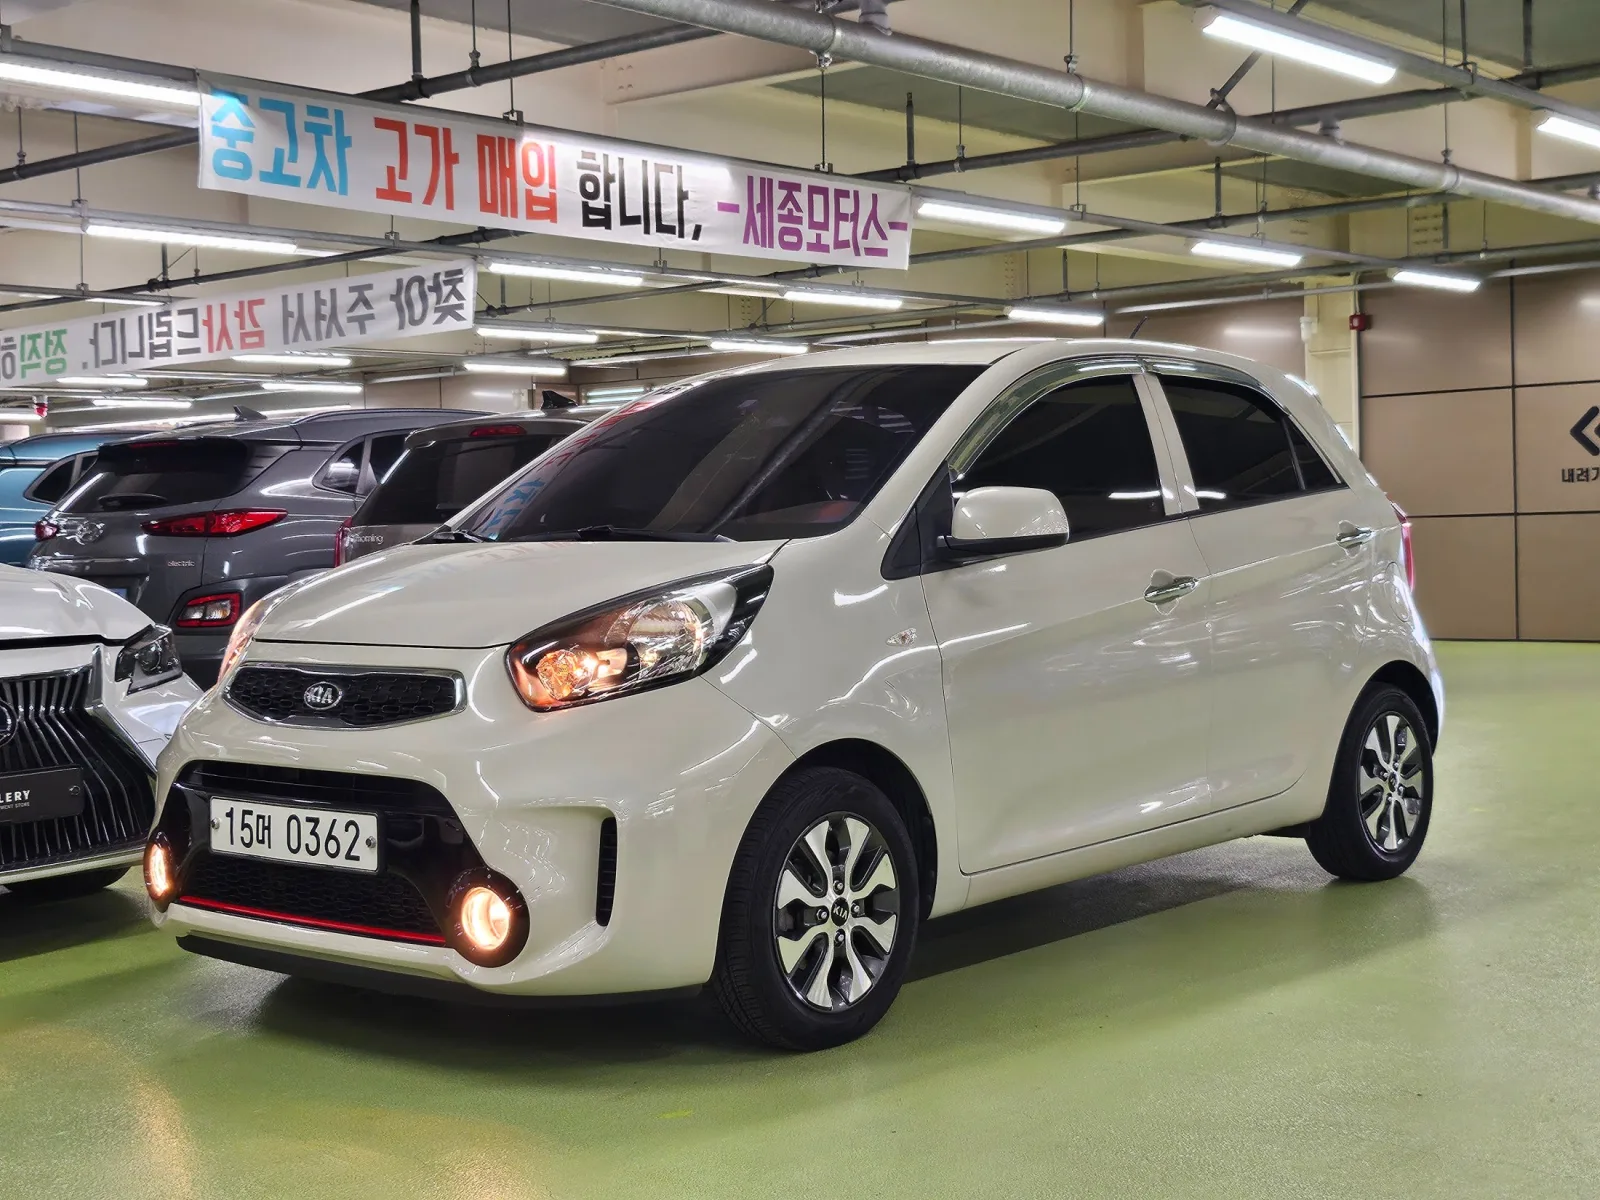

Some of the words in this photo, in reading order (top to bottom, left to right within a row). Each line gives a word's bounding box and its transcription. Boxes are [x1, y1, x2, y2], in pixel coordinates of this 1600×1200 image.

[211, 87, 352, 196] 중고차
[374, 116, 460, 210] 고가
[477, 134, 558, 224] 매입
[577, 150, 703, 241] 합니다,
[306, 686, 333, 703] KIA
[225, 807, 271, 849] 15머
[287, 814, 361, 862] 0362
[833, 905, 847, 920] KIA
